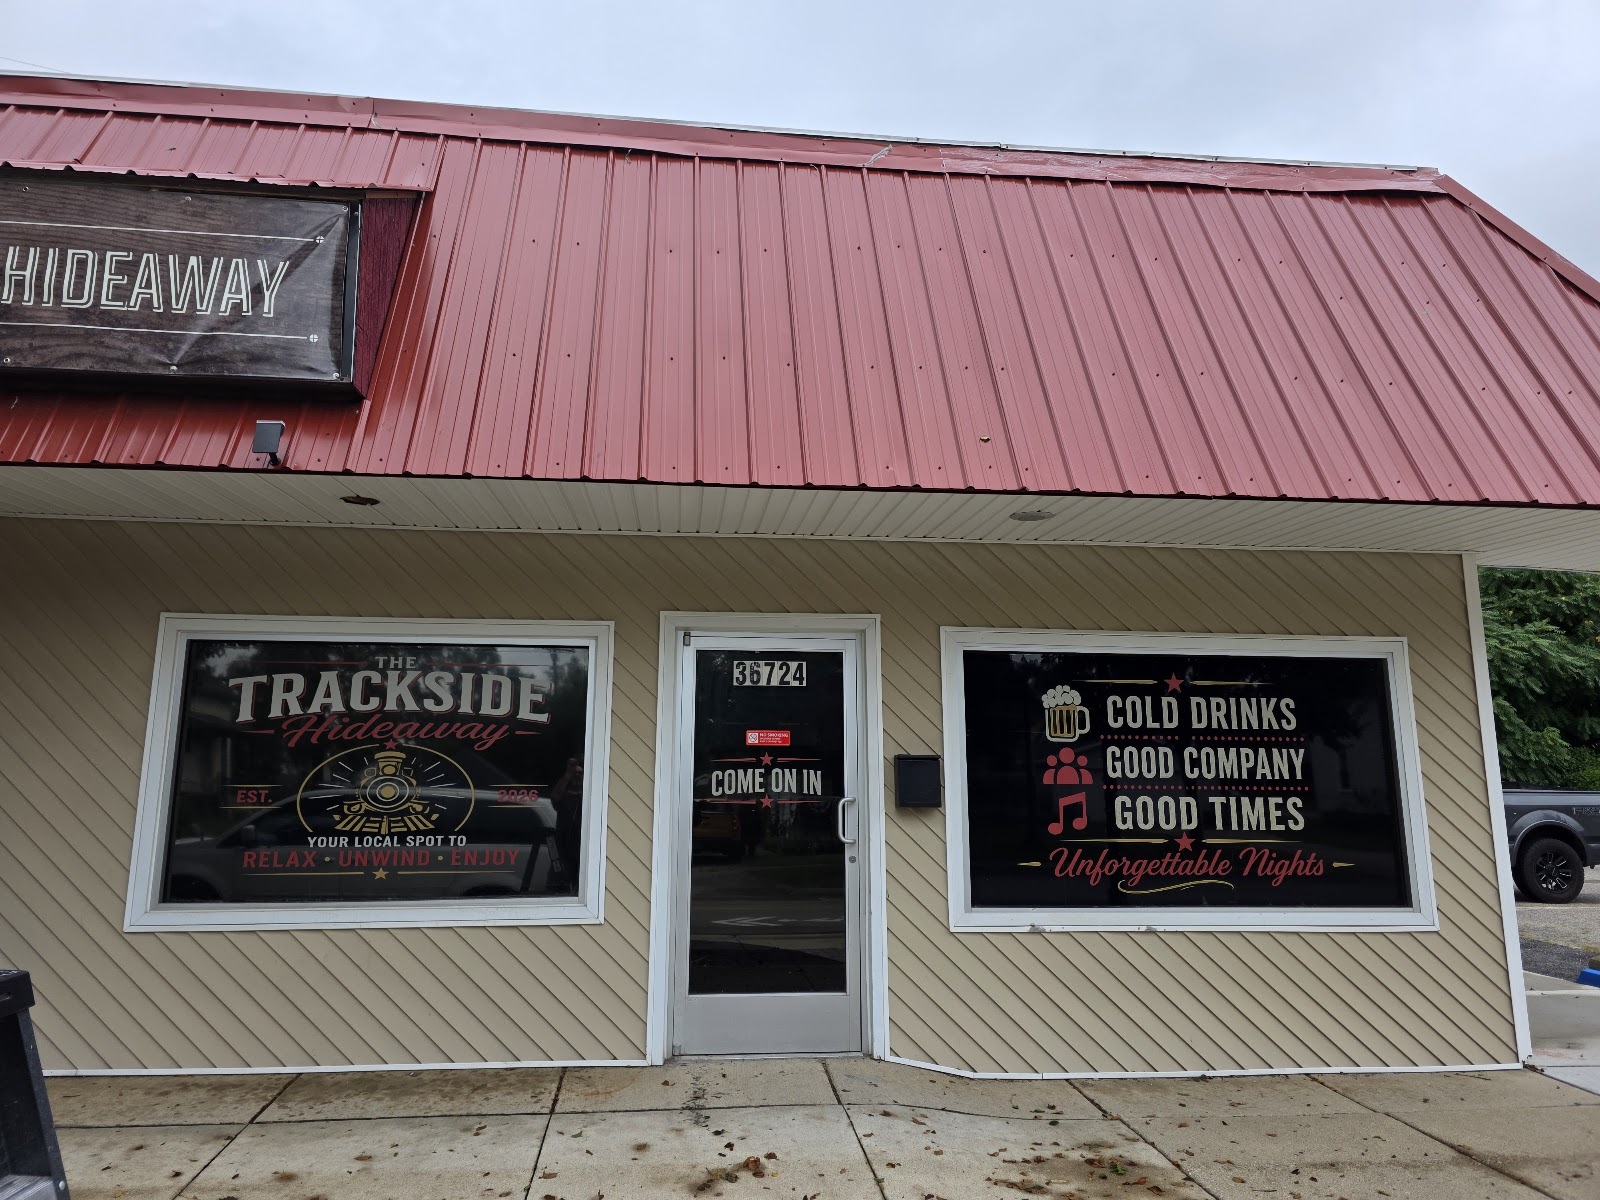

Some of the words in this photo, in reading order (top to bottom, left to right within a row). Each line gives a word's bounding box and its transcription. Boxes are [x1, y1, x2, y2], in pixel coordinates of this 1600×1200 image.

[2, 246, 290, 317] HIDEAWAY
[375, 656, 417, 669] THE
[735, 662, 804, 685] 36724
[229, 670, 553, 725] TRACKSIDE
[1107, 696, 1179, 729] COLD
[1190, 697, 1297, 730] DRINKS
[282, 714, 510, 750] Hideaway
[1107, 746, 1174, 779] GOOD
[1184, 747, 1305, 780] COMPANY
[236, 789, 272, 804] EST.
[497, 789, 539, 803] 2026
[711, 769, 765, 796] COME
[771, 768, 797, 793] ON
[803, 770, 822, 795] IN
[1115, 796, 1198, 830] GOOD
[1208, 796, 1305, 831] TIMES
[307, 836, 349, 848] YOUR
[354, 836, 400, 848] LOCAL
[406, 836, 443, 848] SPOT
[448, 835, 467, 847] TO
[242, 851, 316, 868] RELAX
[339, 850, 430, 867] UNWIND
[450, 849, 520, 867] ENJOY
[1049, 847, 1233, 887] Unforgettable
[1239, 847, 1325, 887] Nights
